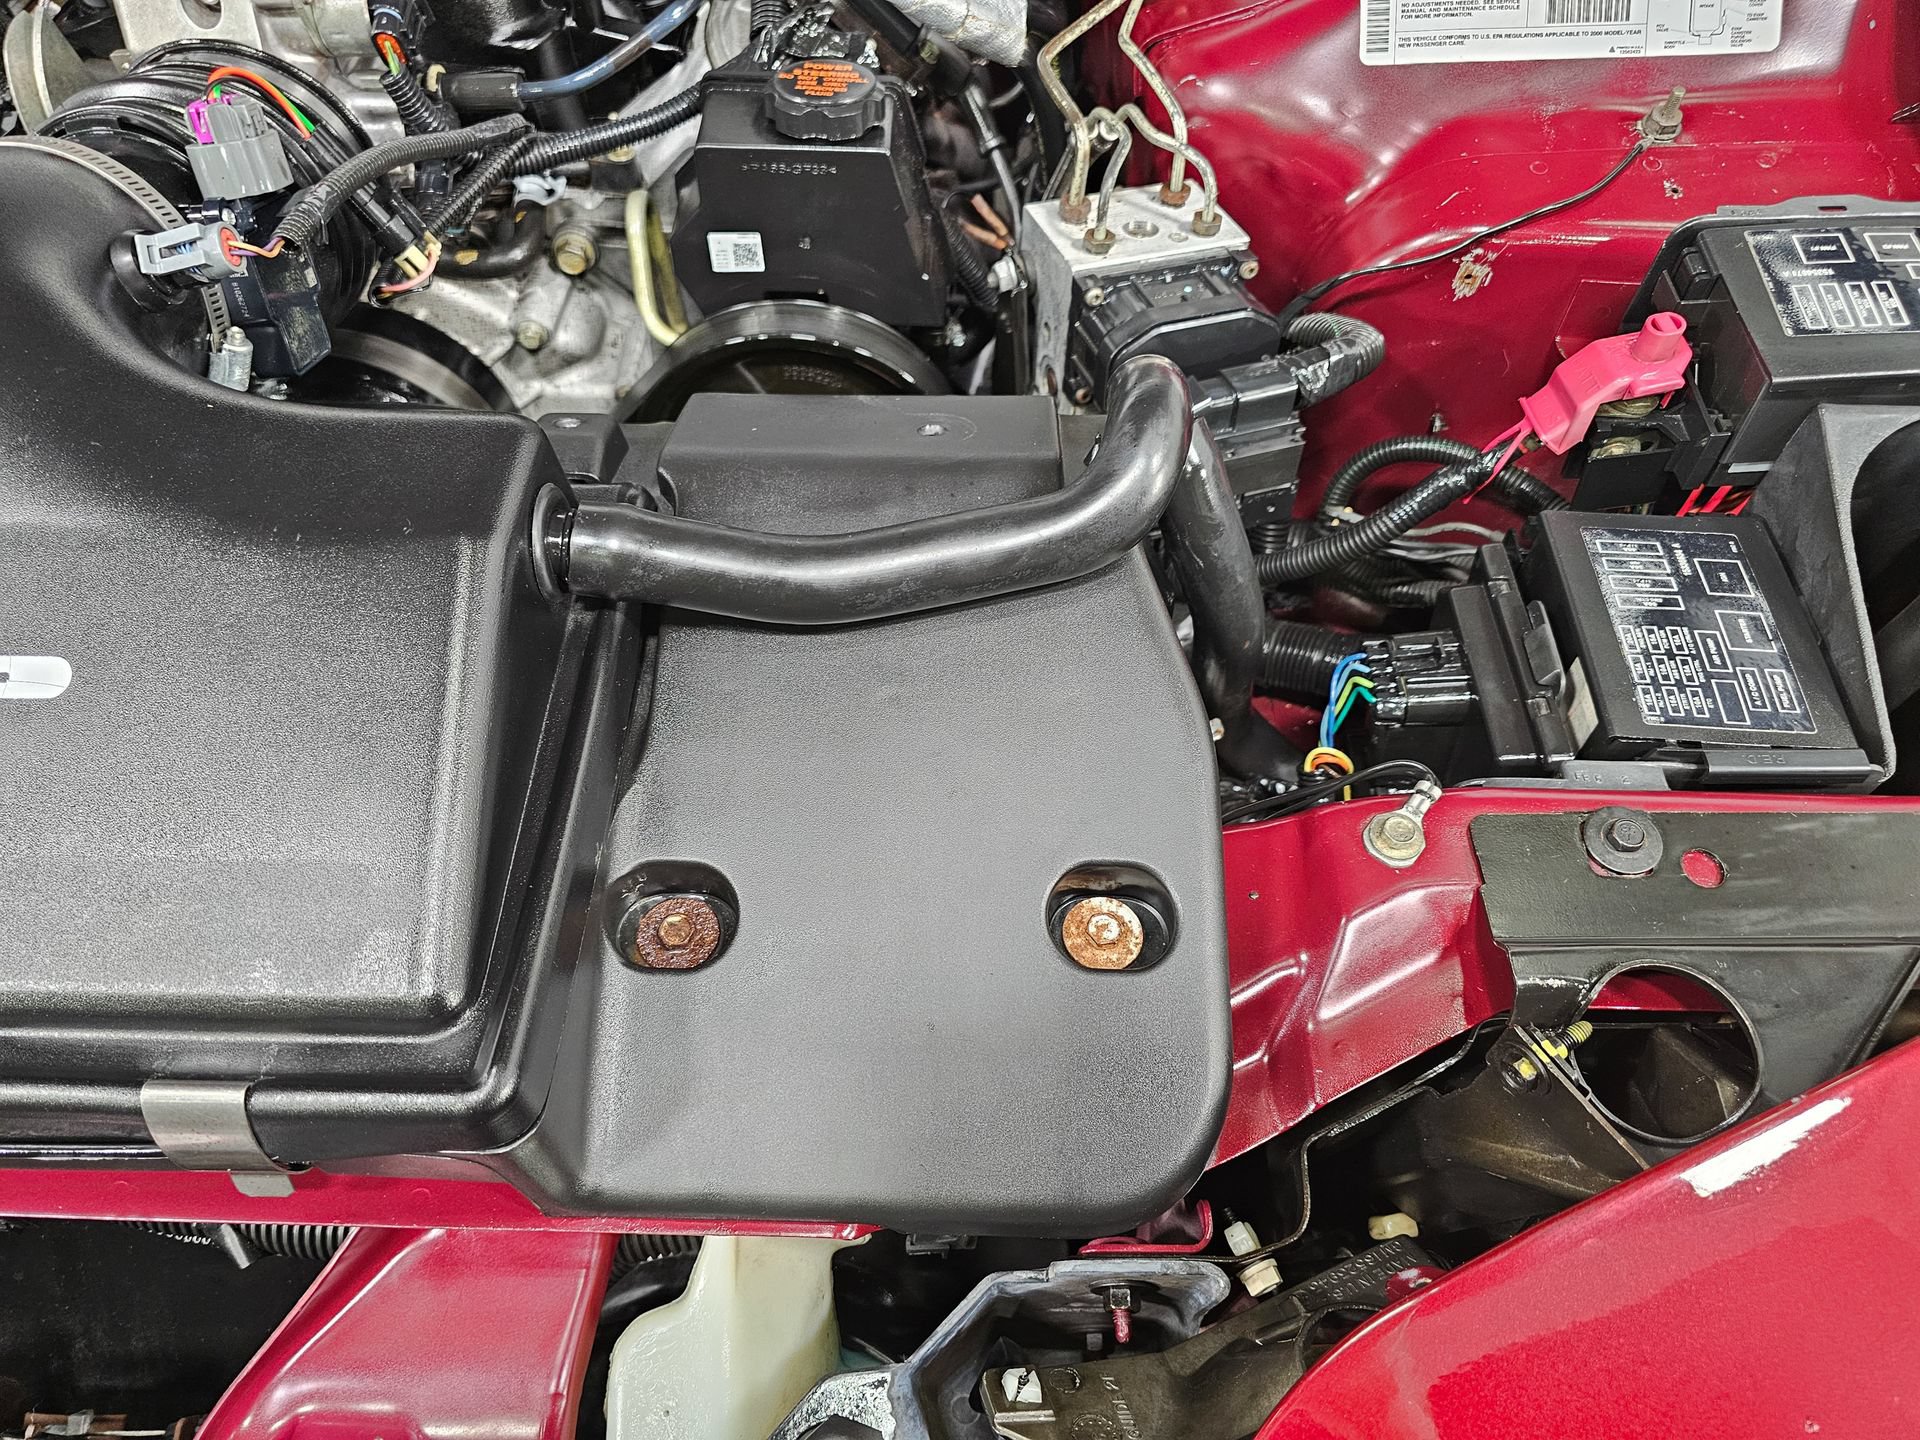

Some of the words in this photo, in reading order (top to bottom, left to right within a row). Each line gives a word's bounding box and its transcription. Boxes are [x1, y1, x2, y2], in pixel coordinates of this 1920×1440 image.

[793, 68, 860, 78] STEERING
[804, 62, 853, 72] POWER
[1738, 619, 1753, 643] STARTER
[1706, 638, 1717, 654] PUMP
[1712, 654, 1722, 665] AIR
[1745, 674, 1757, 691] COMP
[1773, 674, 1784, 692] PUMP
[1780, 692, 1790, 708] FUEL
[1378, 1241, 1402, 1258] GM
[1377, 1253, 1418, 1281] MADE
